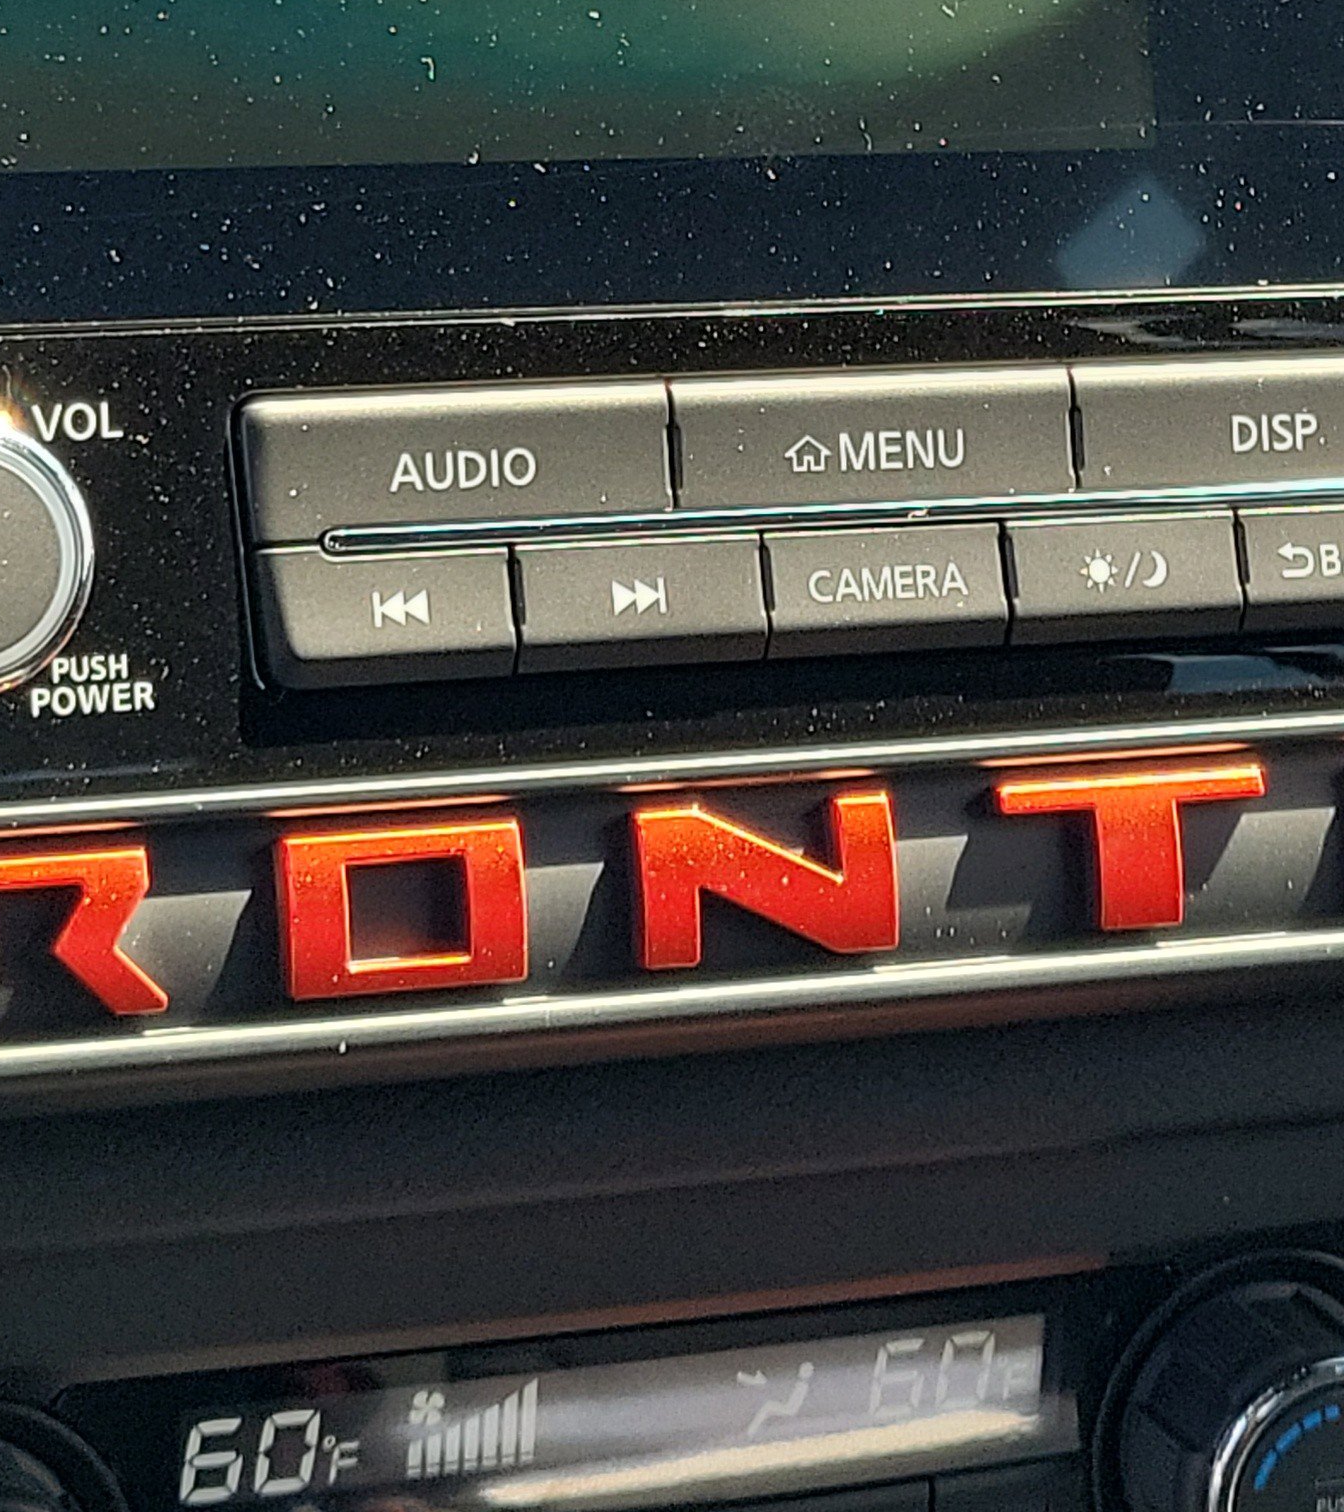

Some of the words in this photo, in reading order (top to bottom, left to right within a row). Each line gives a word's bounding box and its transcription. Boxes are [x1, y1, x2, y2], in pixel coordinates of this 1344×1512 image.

[31, 402, 124, 442] VOL
[1230, 413, 1320, 455] DISP
[388, 447, 538, 494] AUDIO
[838, 428, 967, 473] MENU
[807, 561, 969, 606] CAMERA
[51, 653, 130, 682] PUSH
[29, 680, 156, 718] POWER
